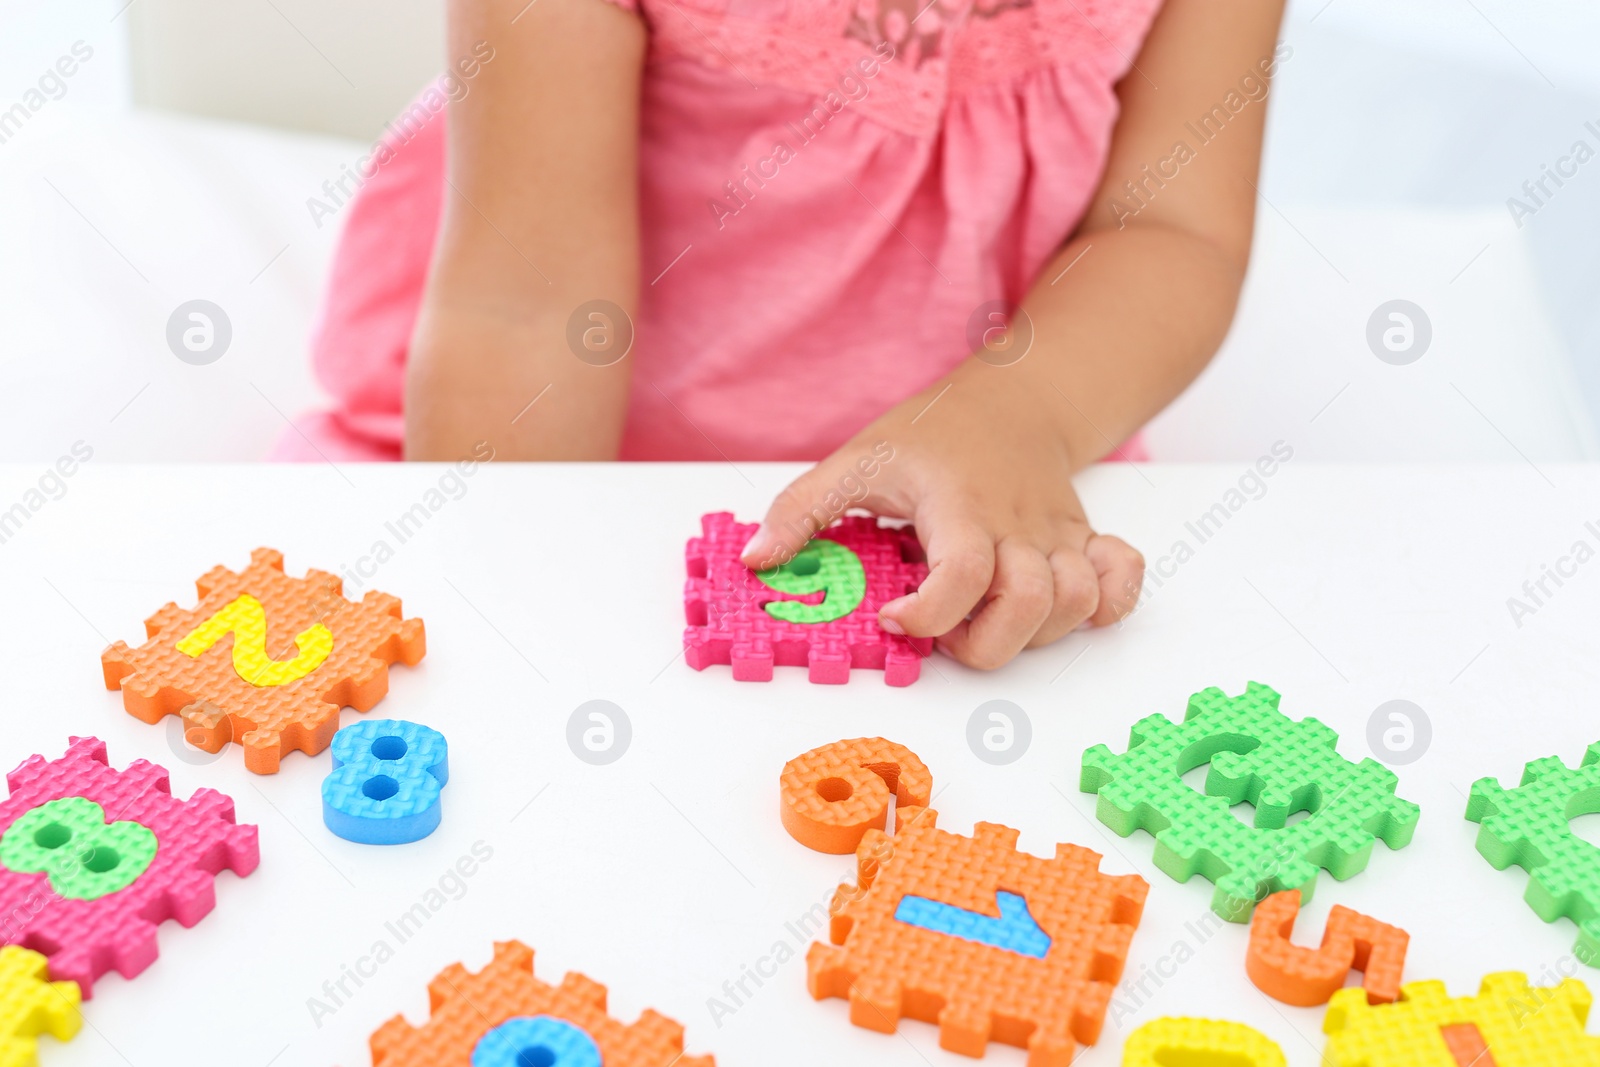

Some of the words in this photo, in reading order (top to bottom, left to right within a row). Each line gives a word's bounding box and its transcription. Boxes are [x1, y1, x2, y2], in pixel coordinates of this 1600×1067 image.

[175, 593, 334, 688] 2
[322, 719, 449, 846] 8
[0, 796, 158, 901] 8
[894, 888, 1051, 959] 1
[1246, 889, 1410, 1008] 5
